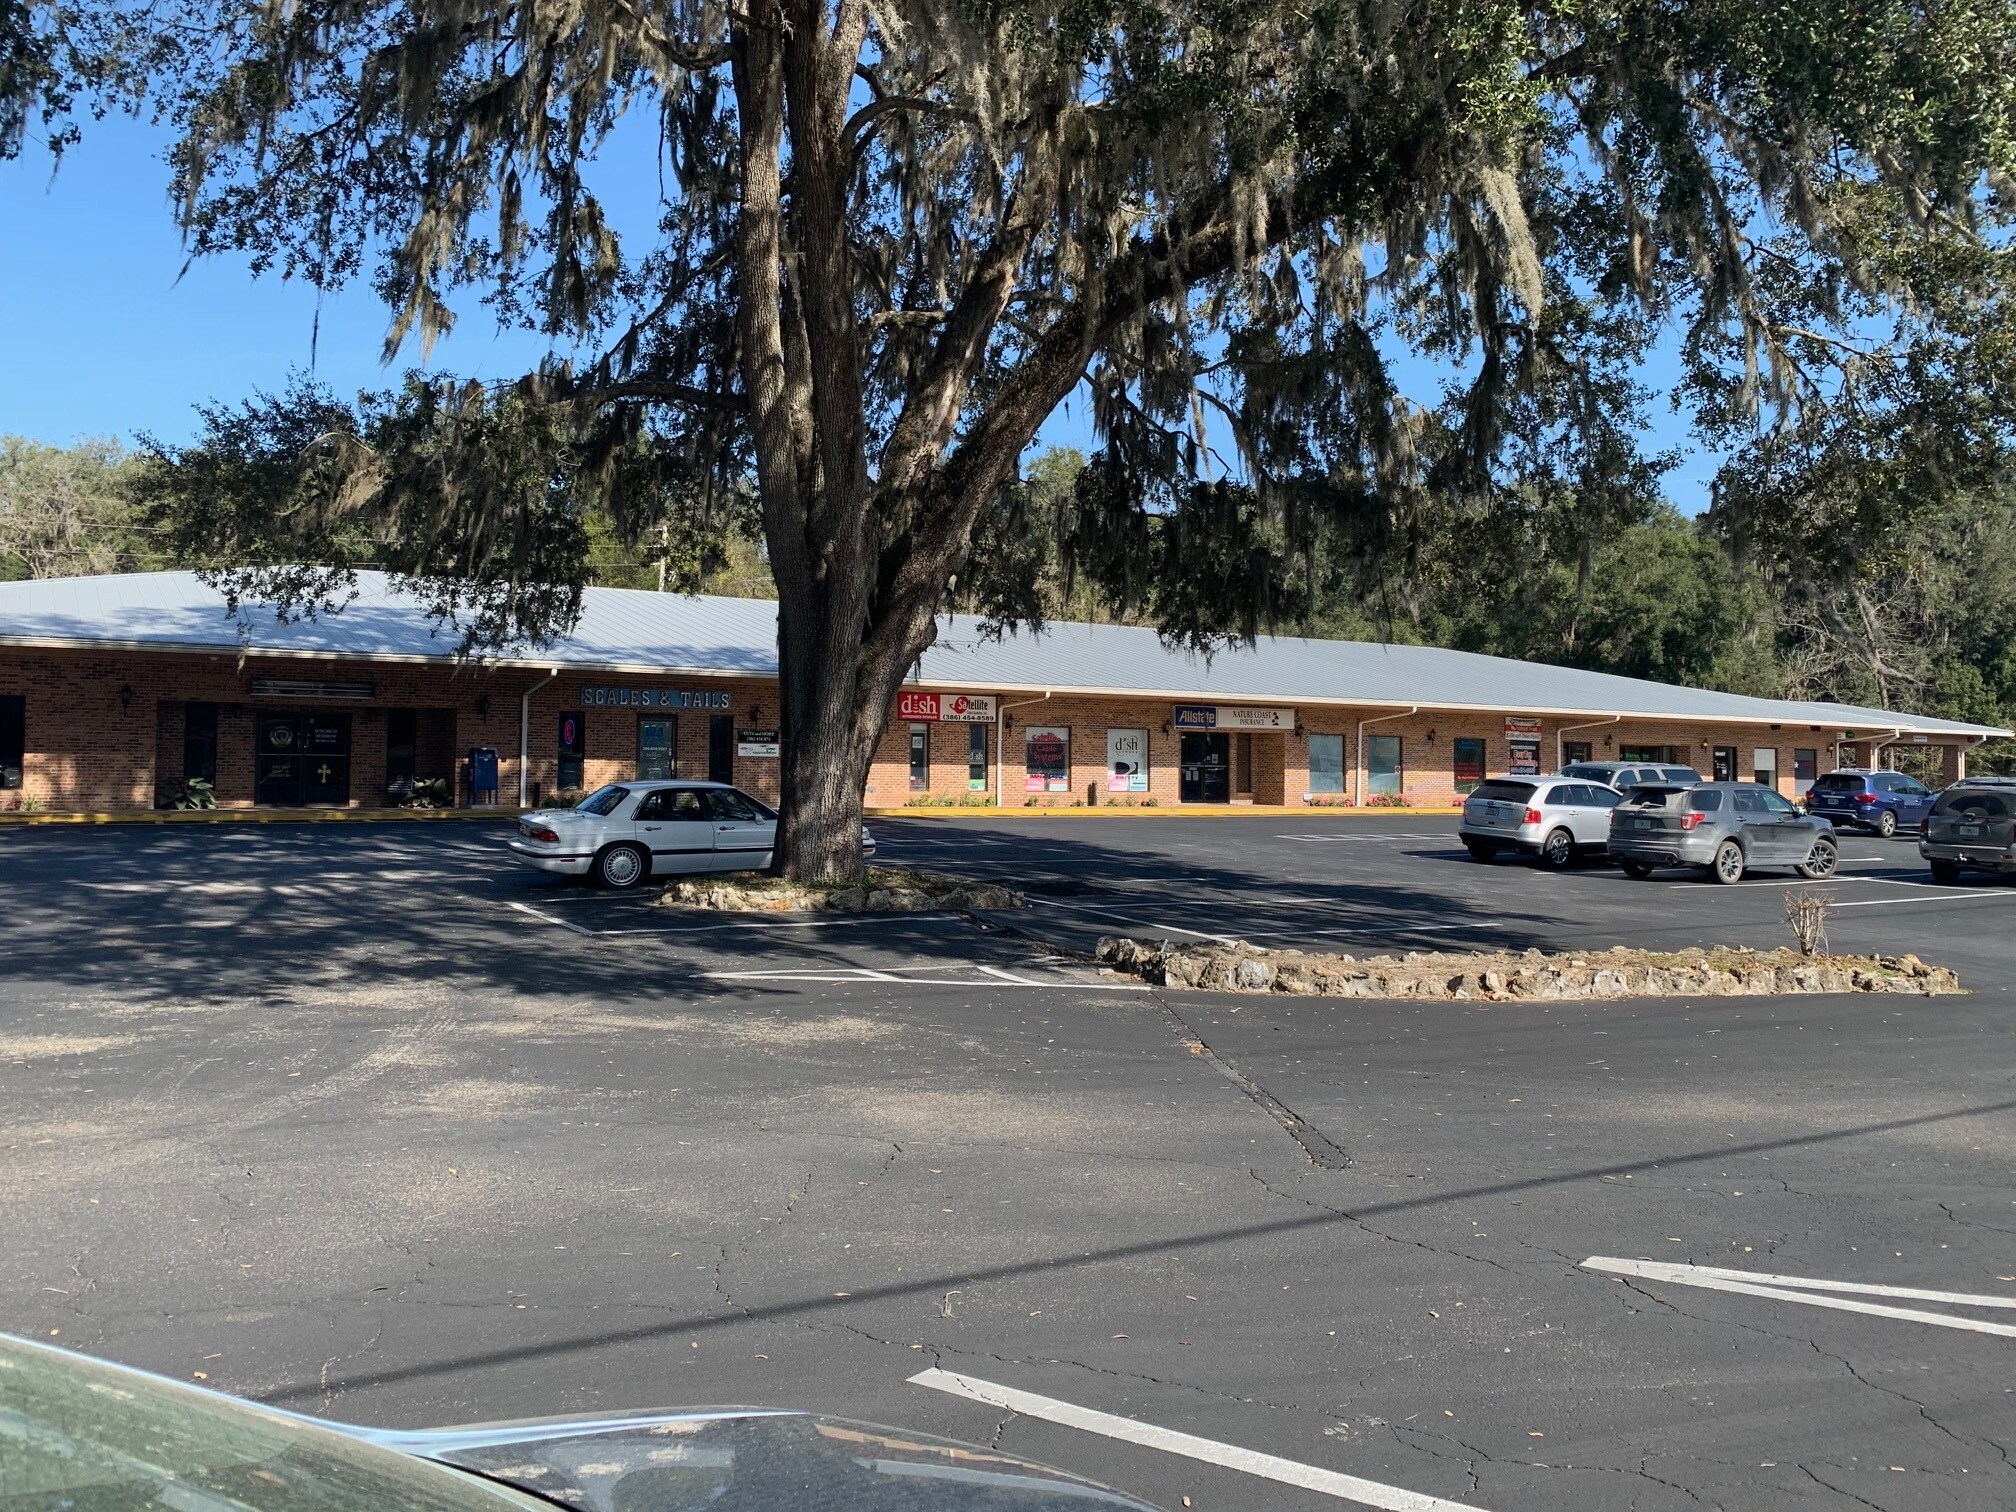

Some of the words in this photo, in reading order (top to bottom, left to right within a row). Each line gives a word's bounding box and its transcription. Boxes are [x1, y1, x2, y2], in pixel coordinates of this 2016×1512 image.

[584, 689, 650, 706] SCALES
[660, 691, 671, 706] &
[680, 692, 730, 708] TAILS
[901, 694, 938, 715] dish
[957, 698, 989, 711] Satellite
[1179, 711, 1215, 724] Allstate
[1232, 710, 1254, 719] NATURE
[1254, 711, 1271, 719] COAST
